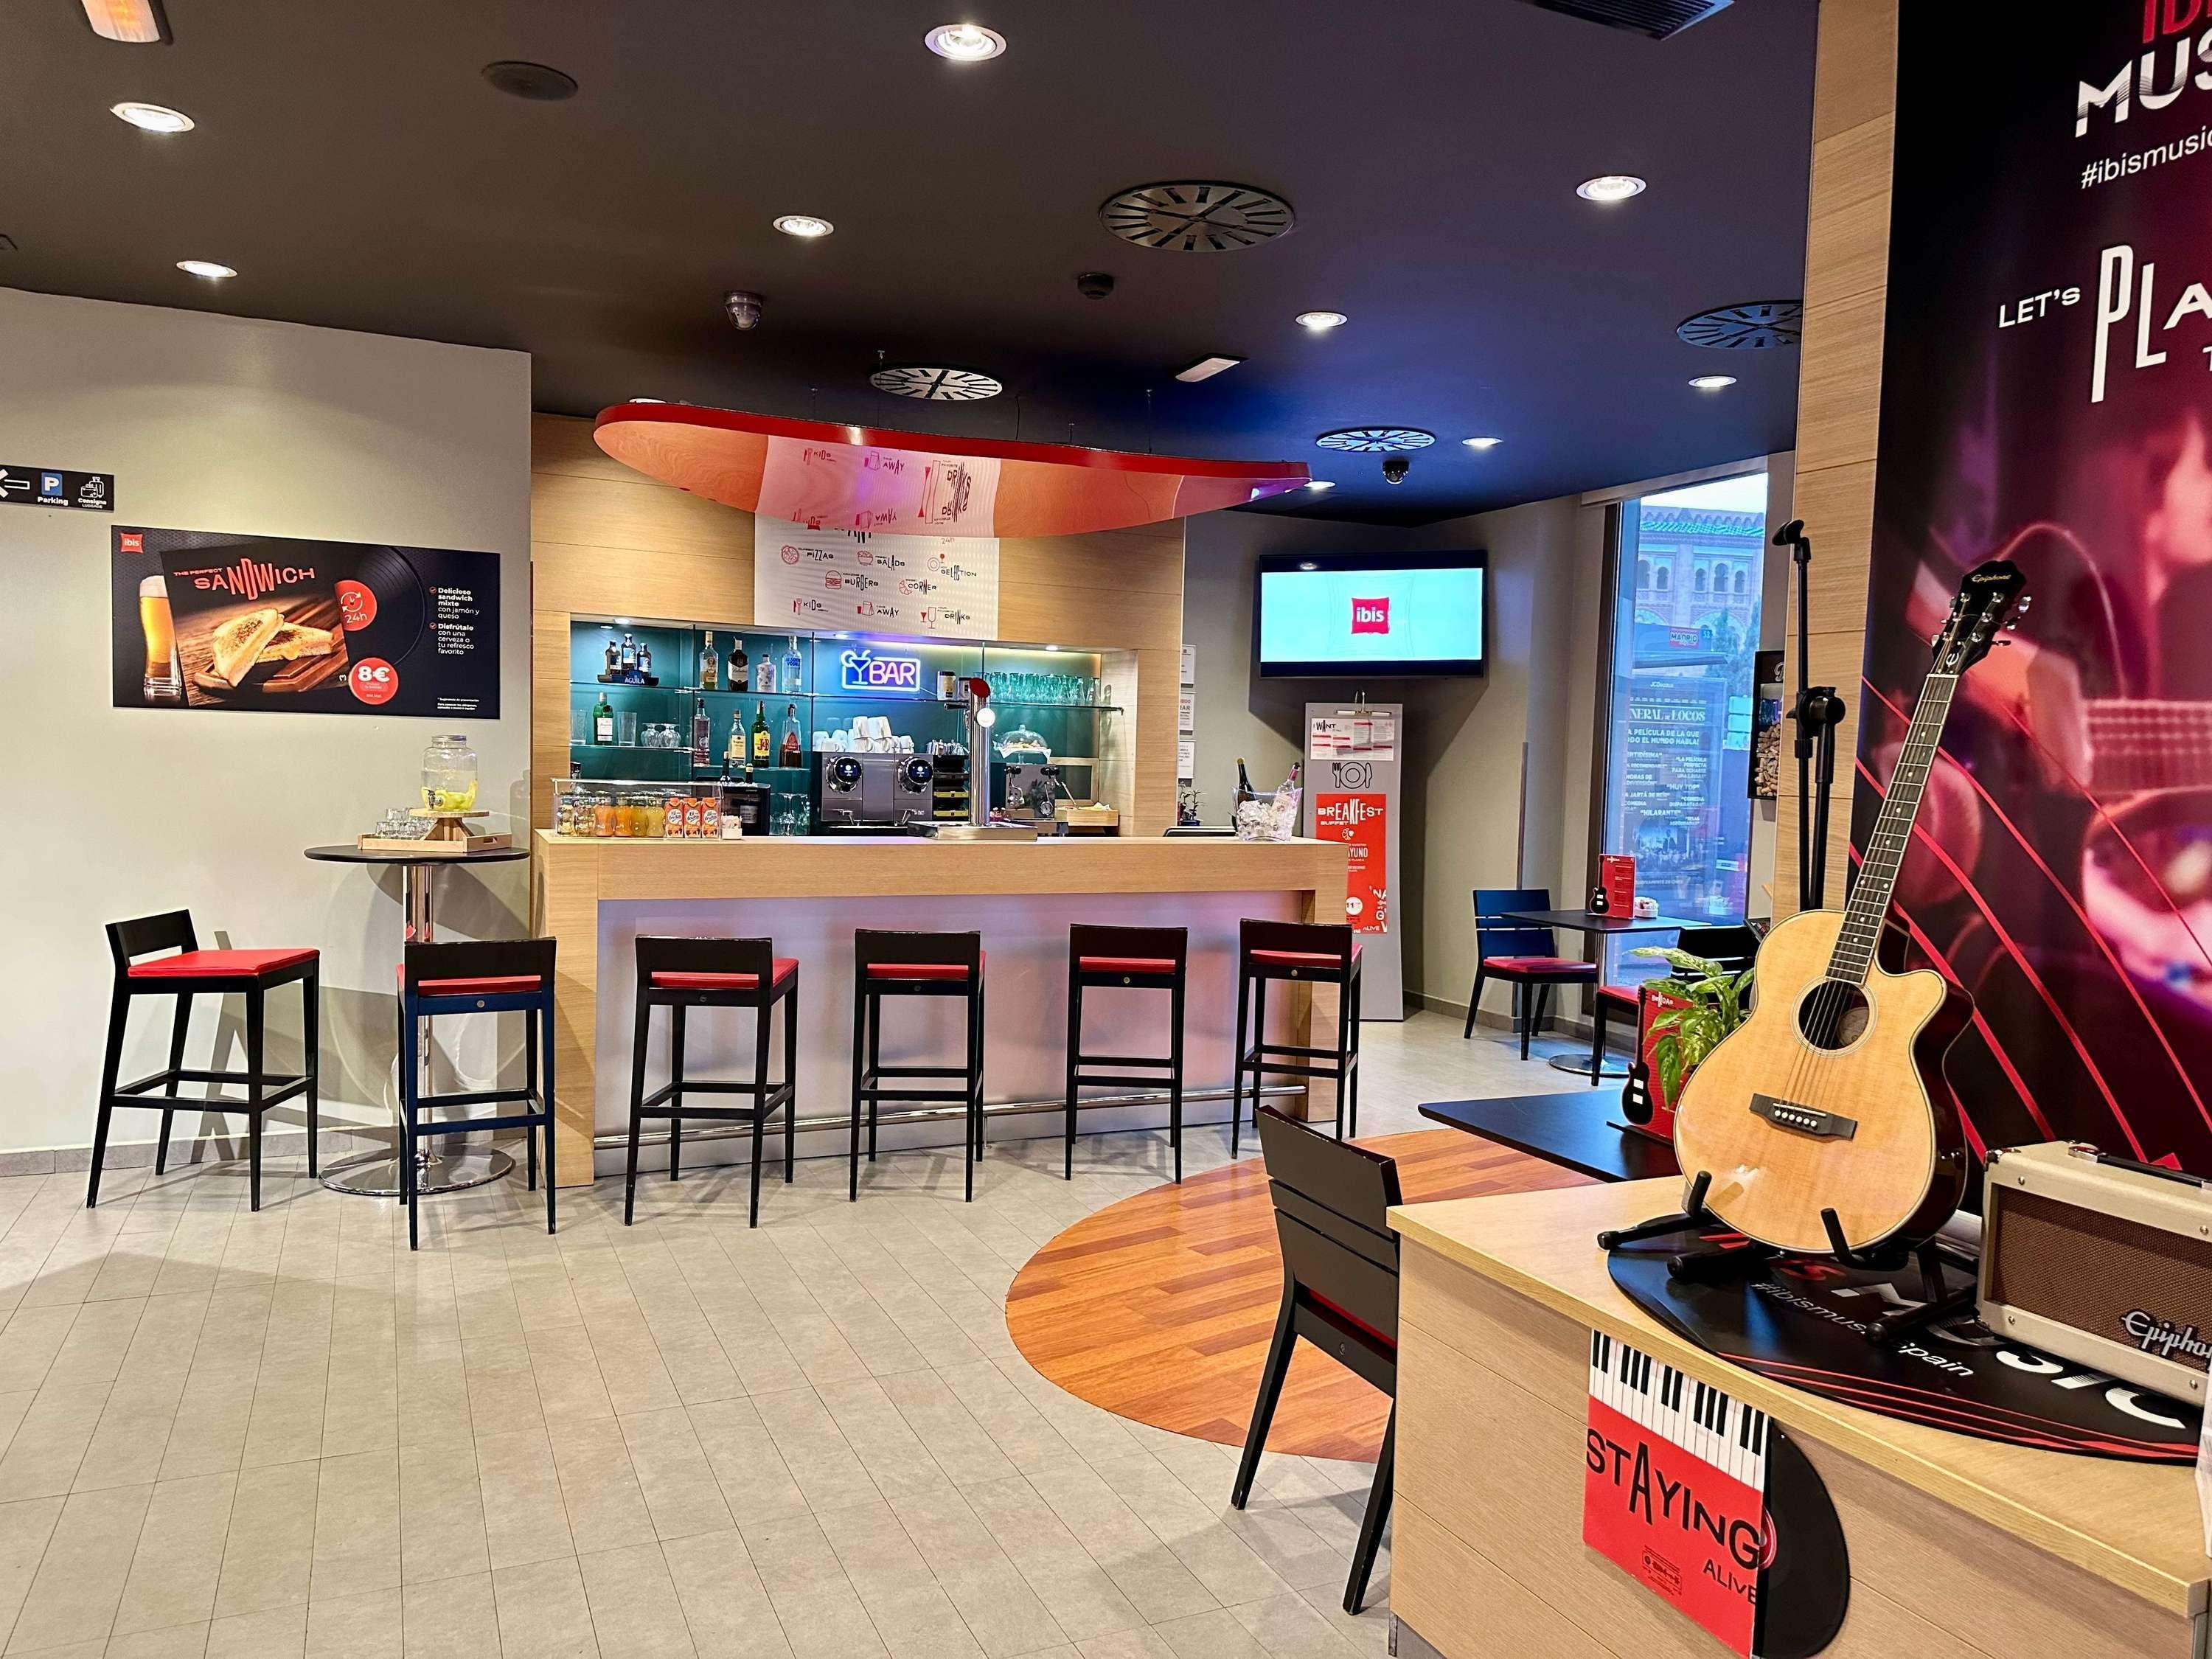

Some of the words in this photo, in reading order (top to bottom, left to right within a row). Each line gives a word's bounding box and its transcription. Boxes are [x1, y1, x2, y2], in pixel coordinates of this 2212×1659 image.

[38, 496, 69, 507] Parking
[77, 498, 107, 506] Consigna
[124, 538, 140, 546] ibis
[807, 549, 834, 561] PIZZAS
[877, 555, 905, 571] SALADS
[194, 558, 316, 600] SANDWICH
[844, 574, 879, 591] BURGERS
[908, 579, 936, 595] CORNER
[803, 599, 822, 611] KIDS
[877, 608, 900, 618] AWAY
[344, 612, 368, 624] 24h
[945, 609, 970, 625] DRINKS
[1357, 606, 1385, 623] ibis
[438, 623, 474, 631] Disfrútalo
[358, 665, 390, 683] 8€
[869, 661, 916, 685] BAR
[1630, 708, 1663, 720] NERAL
[1672, 709, 1705, 721] LOCOS
[1634, 728, 1665, 736] PELÍCULA
[1317, 799, 1384, 824] BREAKFEST
[1586, 1427, 1760, 1571] STAYING
[1703, 1558, 1757, 1606] ALIVE
